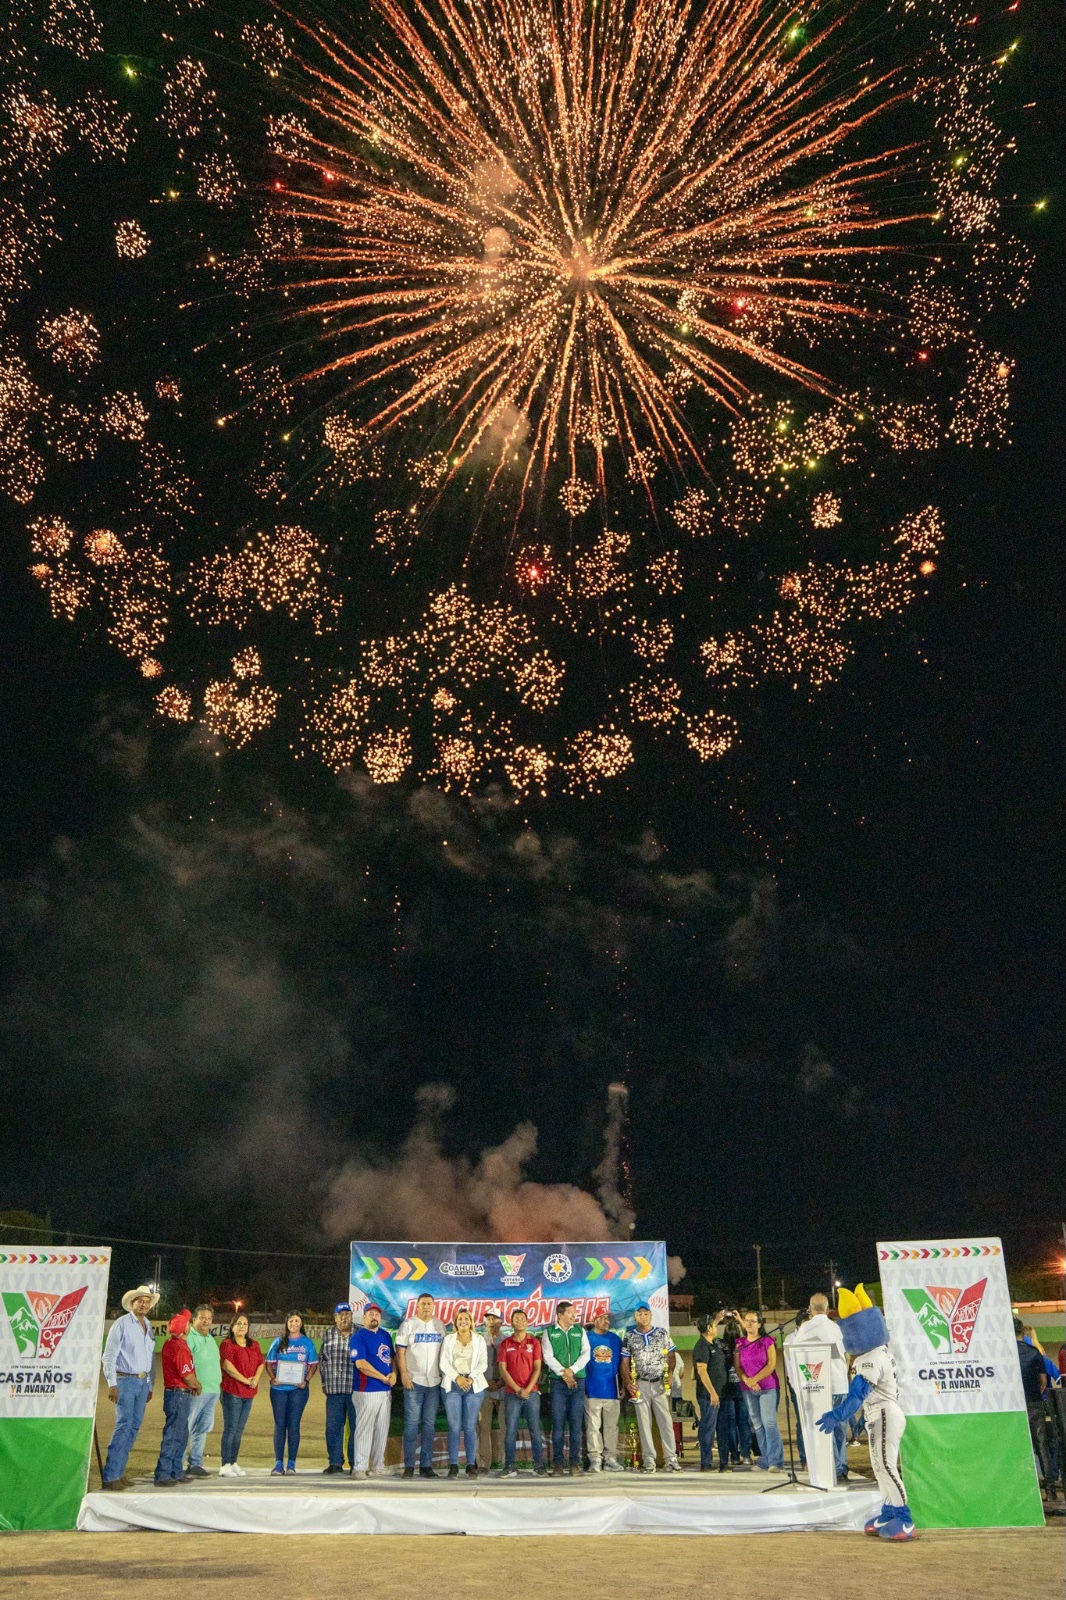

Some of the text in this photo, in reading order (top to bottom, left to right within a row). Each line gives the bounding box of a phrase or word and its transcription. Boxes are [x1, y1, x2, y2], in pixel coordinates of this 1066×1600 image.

[440, 1262, 484, 1274] COAHUILA
[0, 1370, 73, 1383] CASTAÑOS
[918, 1365, 995, 1381] CASTAÑOS
[11, 1384, 55, 1393] YA AVANZA
[935, 1380, 980, 1390] YA AVANZA
